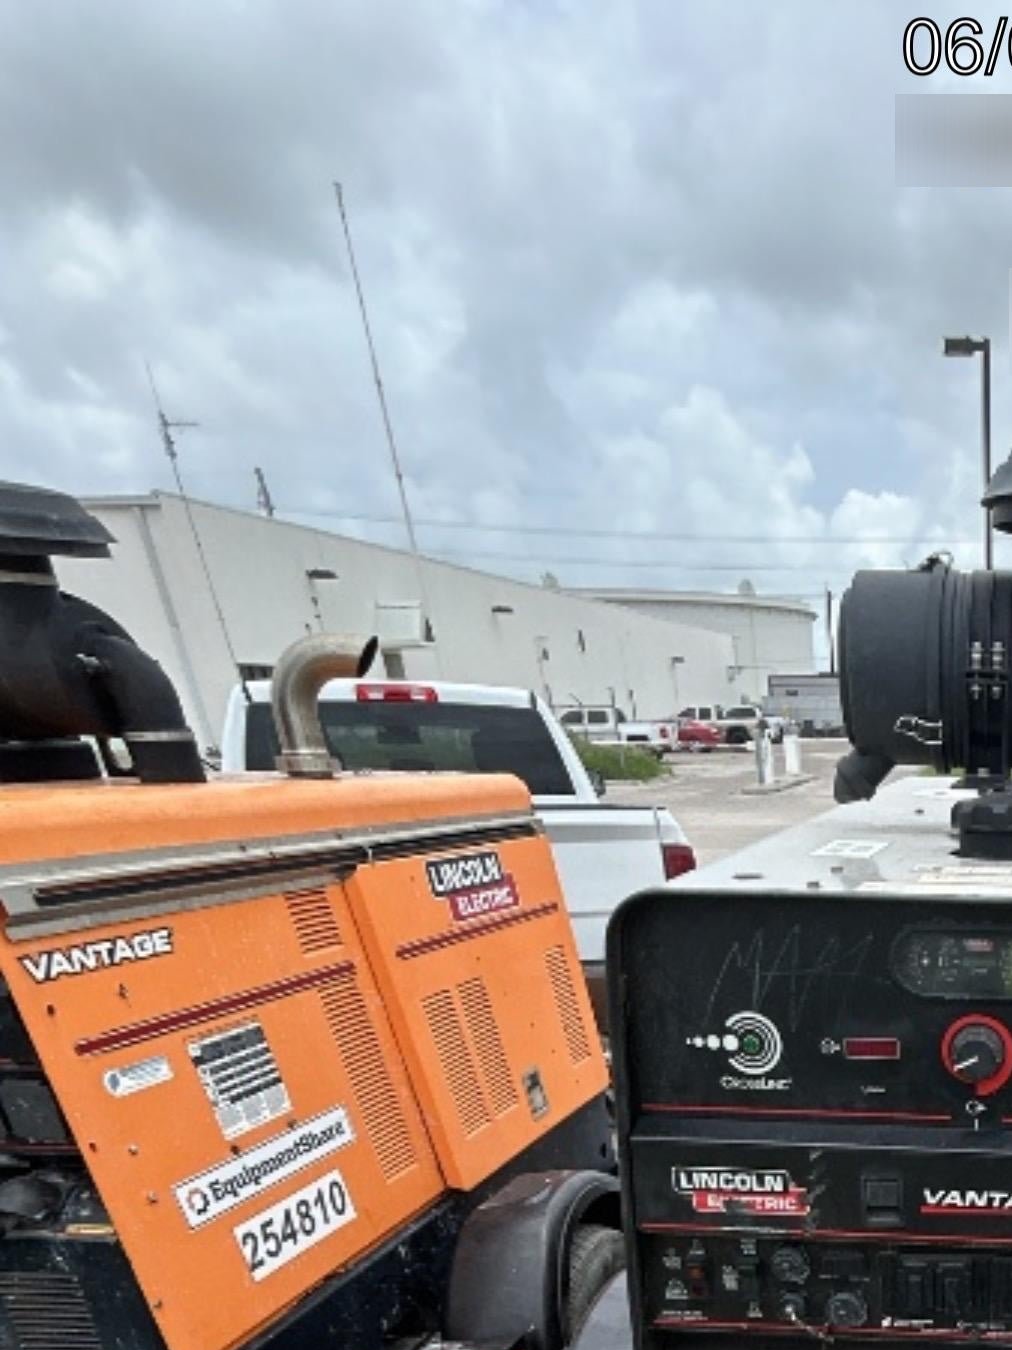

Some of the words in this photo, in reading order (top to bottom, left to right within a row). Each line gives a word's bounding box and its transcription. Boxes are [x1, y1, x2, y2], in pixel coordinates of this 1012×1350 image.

[429, 855, 501, 892] LINCOLN
[21, 928, 173, 982] VANTAGE
[209, 1121, 347, 1202] EquipmentShare
[679, 1171, 785, 1193] LINCOLN
[242, 1179, 347, 1272] 254810
